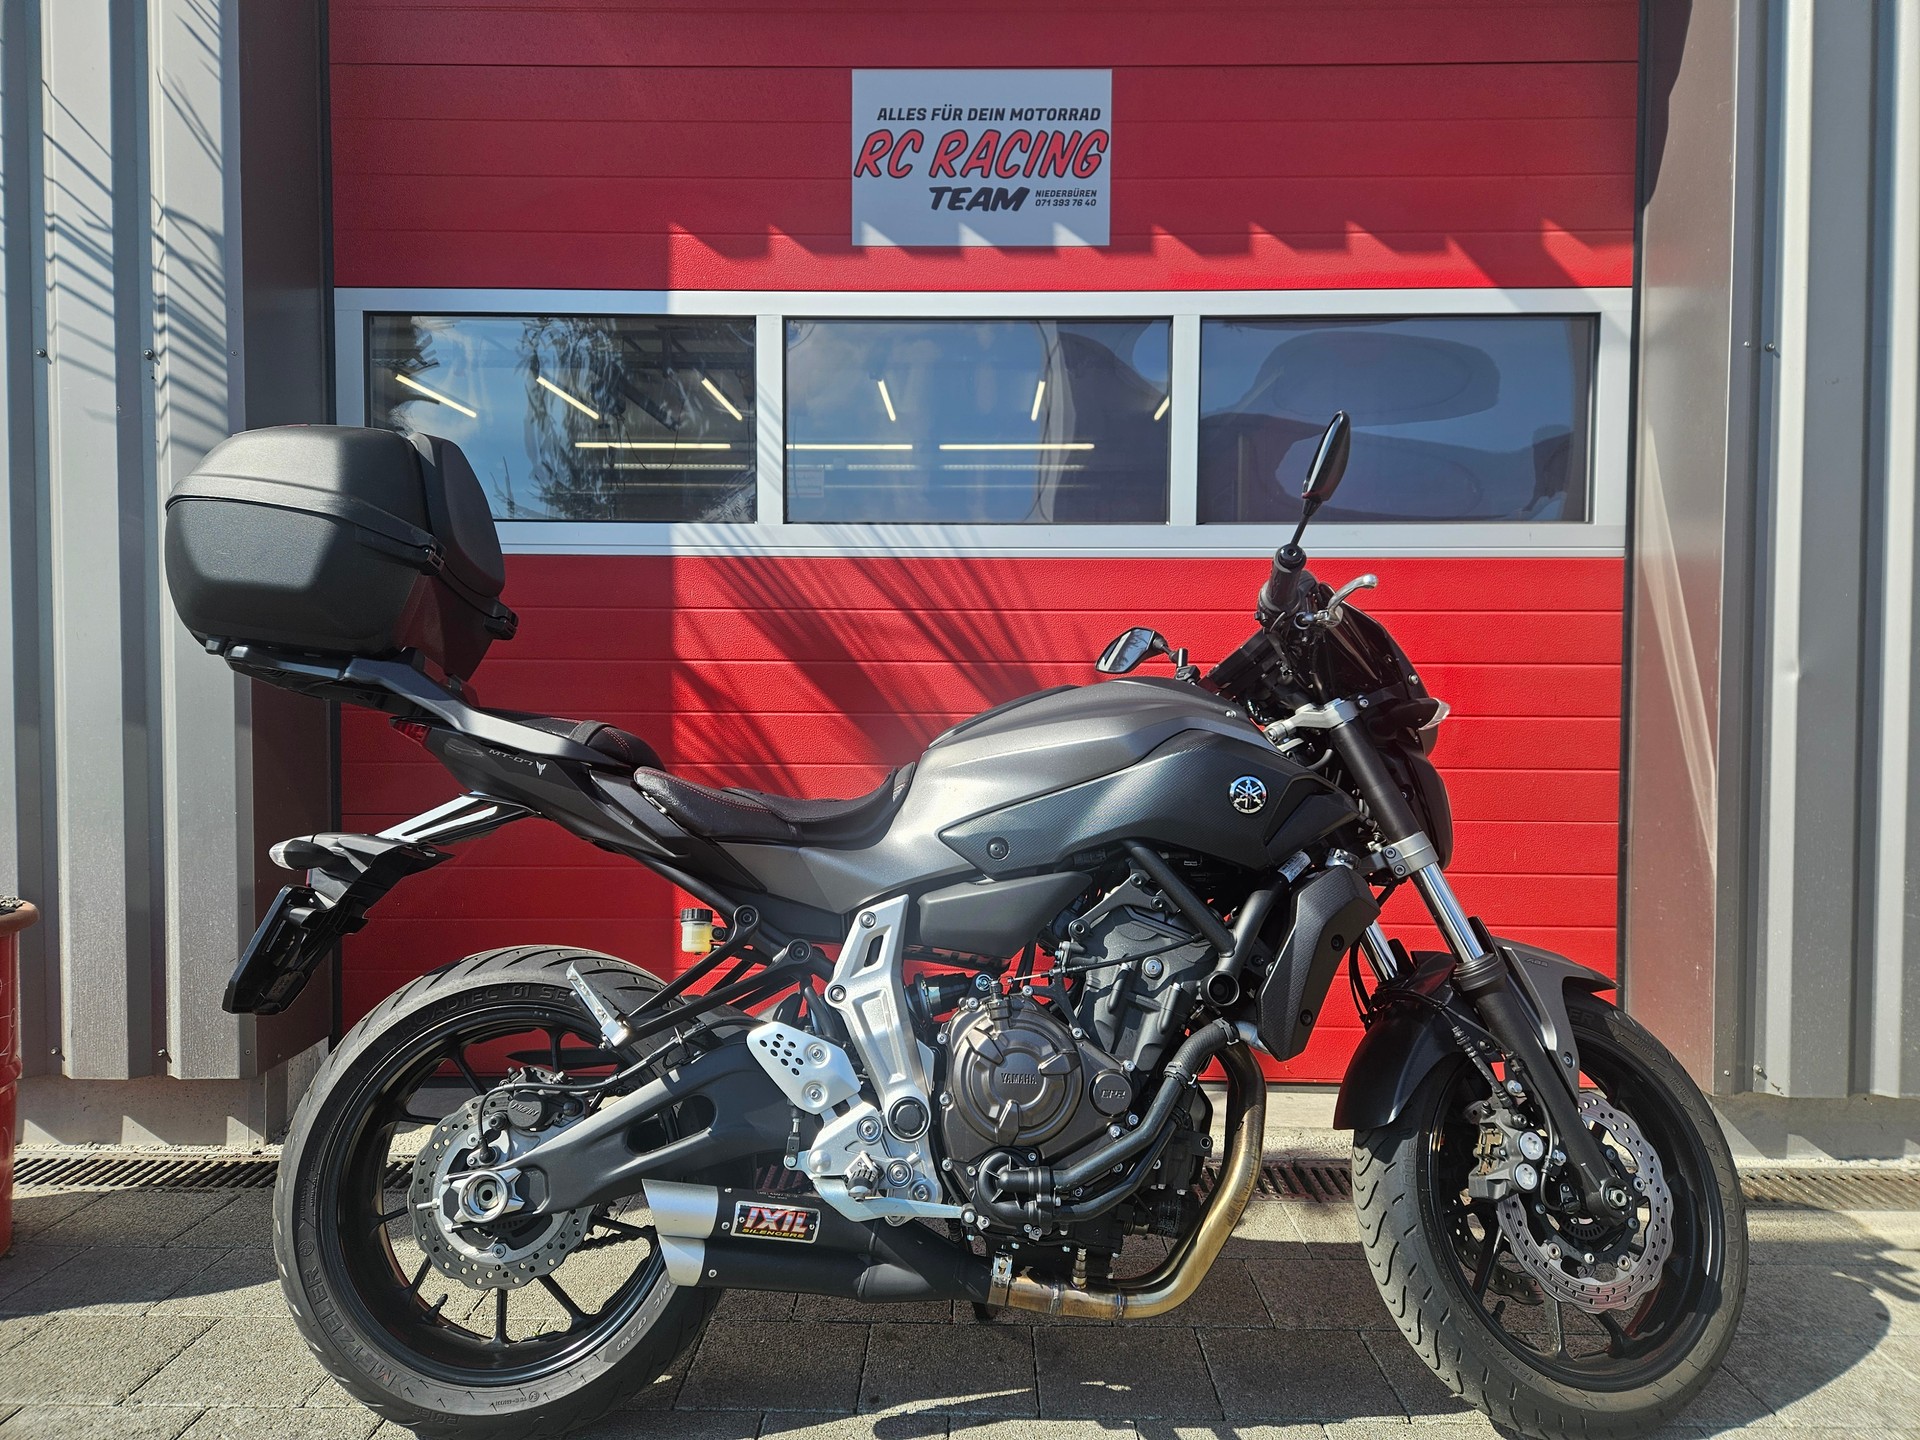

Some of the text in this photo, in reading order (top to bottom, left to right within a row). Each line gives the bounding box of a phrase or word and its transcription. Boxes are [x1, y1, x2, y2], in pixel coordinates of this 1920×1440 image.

[877, 104, 1101, 121] ALLES FÜR DEIN MOTORRAD
[853, 129, 1110, 179] RC RACING
[929, 186, 1030, 212] TEAM
[1035, 188, 1097, 198] NIEDERBÜREN
[1035, 199, 1097, 207] 071 393 76 40
[489, 749, 533, 765] MT-07
[1001, 1072, 1038, 1085] YAMAHA
[744, 1207, 808, 1232] IXIL
[742, 1228, 805, 1238] SILENCERS
[303, 1268, 398, 1388] METZELER
